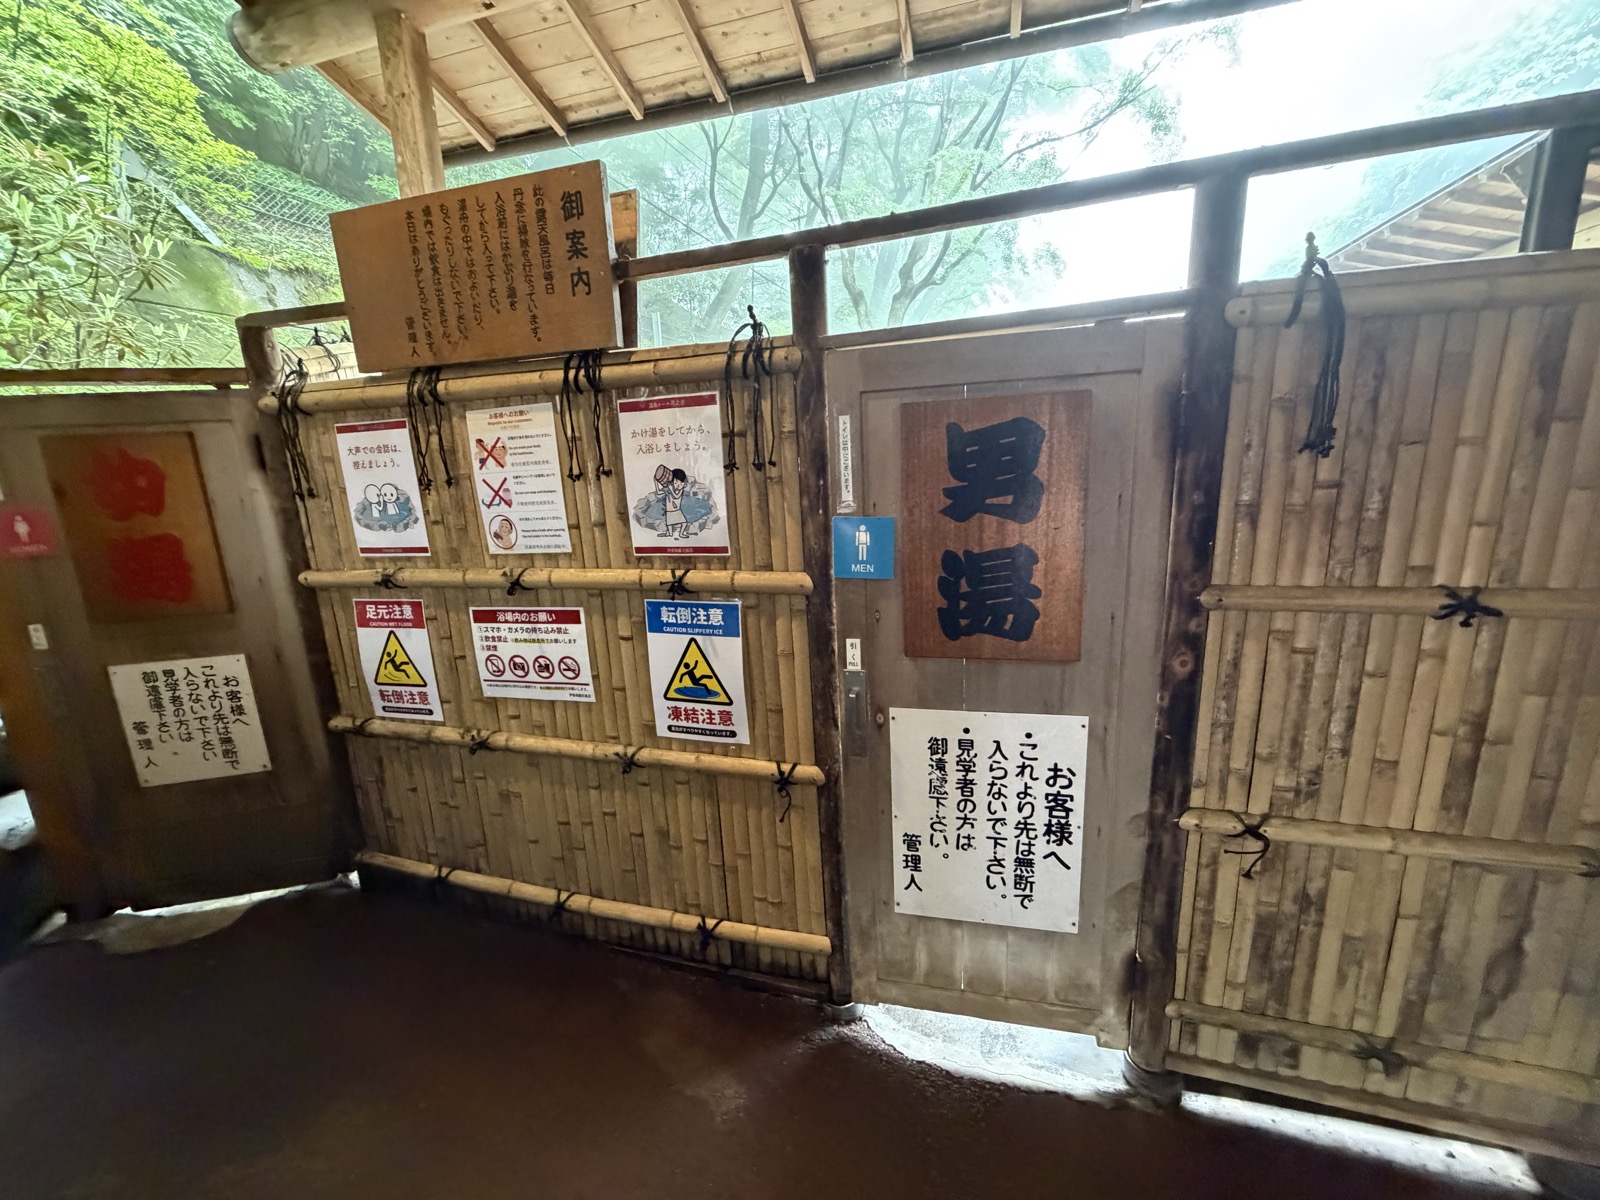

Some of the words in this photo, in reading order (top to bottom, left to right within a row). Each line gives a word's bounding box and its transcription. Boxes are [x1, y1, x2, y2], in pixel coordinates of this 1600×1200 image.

[560, 190, 592, 297] 御案内
[630, 424, 711, 439] かけ湯をしてから、
[636, 442, 707, 455] 入浴しましょう。
[937, 416, 1046, 642] 男湯
[851, 564, 874, 573] MEN
[365, 604, 414, 620] 足元注意
[496, 612, 556, 622] 浴場内のお願い
[660, 605, 724, 626] 転倒注意
[162, 669, 195, 742] 見学者の方は
[201, 665, 241, 770] これより先は無断で
[222, 675, 250, 726] お客様へ
[378, 688, 431, 706] 転倒注意
[667, 705, 735, 727] 凍結注意
[927, 736, 950, 860] 御遠慮下さい。
[985, 739, 1009, 900] 入らないで下さい。
[1042, 762, 1077, 871] お客様へ
[902, 832, 923, 892] 管理人
